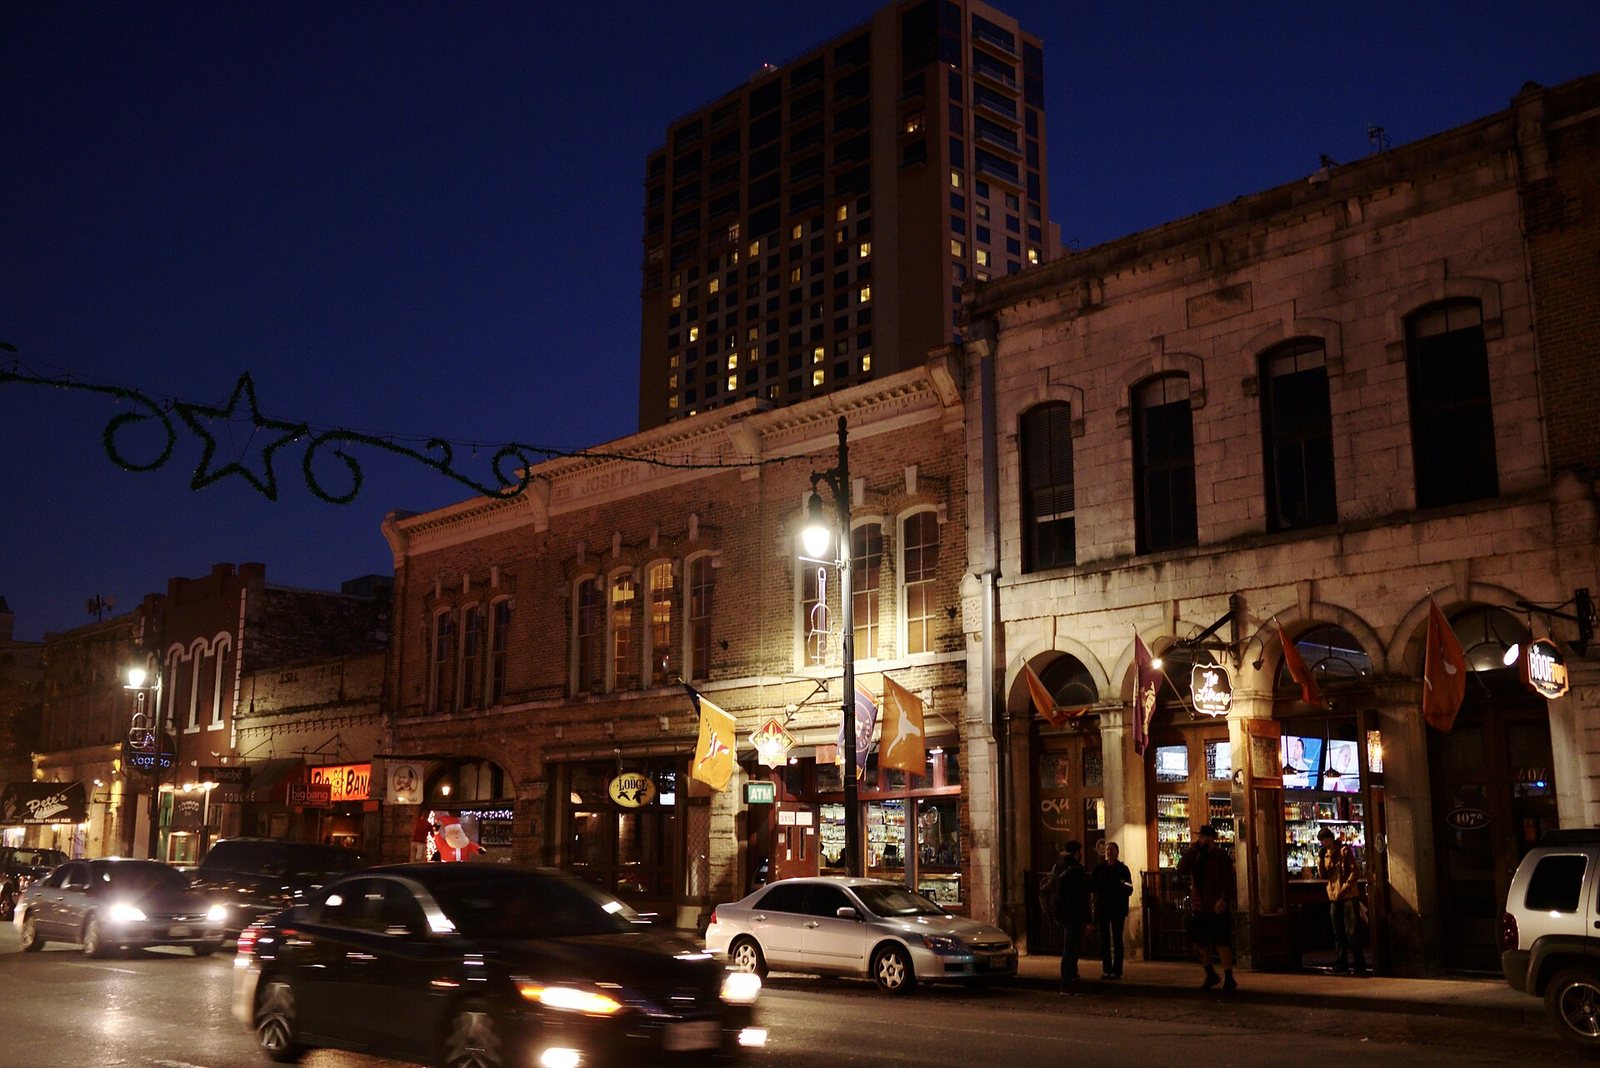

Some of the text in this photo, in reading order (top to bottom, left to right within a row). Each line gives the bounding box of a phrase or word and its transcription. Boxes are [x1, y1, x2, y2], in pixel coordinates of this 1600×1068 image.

[291, 783, 328, 800] big bang
[618, 778, 648, 792] LODGE
[750, 787, 772, 801] ATM
[25, 793, 68, 814] Pete's
